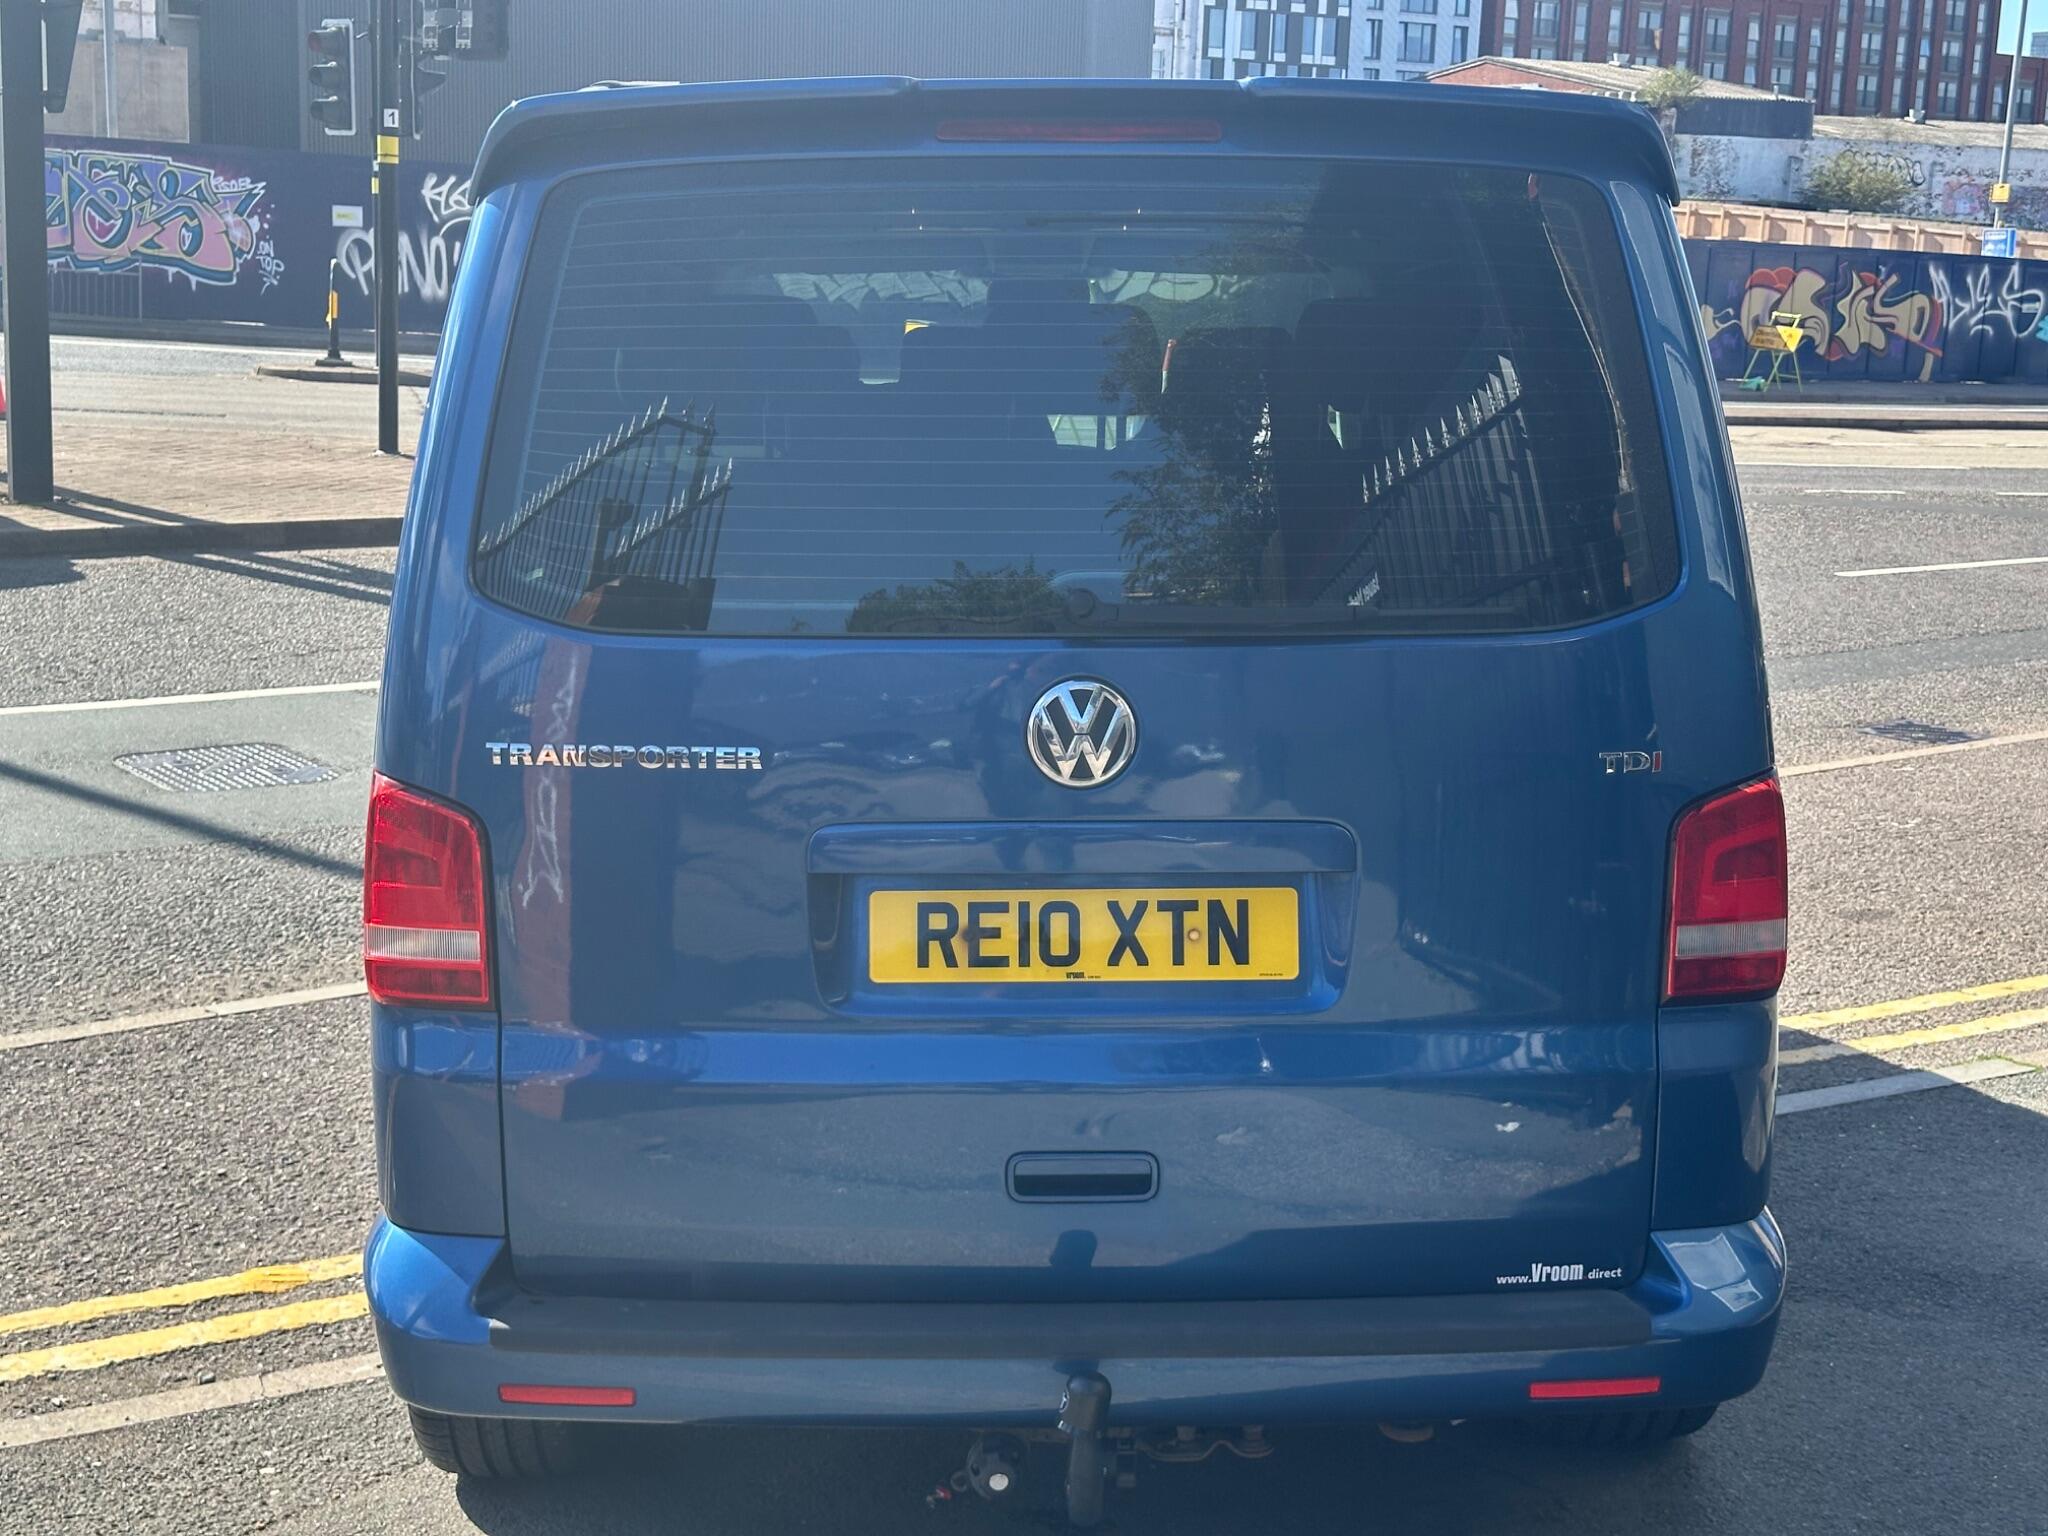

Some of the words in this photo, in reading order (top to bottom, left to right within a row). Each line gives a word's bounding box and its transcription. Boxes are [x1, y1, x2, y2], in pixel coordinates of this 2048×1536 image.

[388, 111, 396, 126] 1
[1028, 681, 1136, 787] VW
[486, 742, 763, 770] TRANSPORTER
[1599, 751, 1662, 773] TDI
[917, 901, 1081, 968] RE10
[1107, 899, 1250, 967] XTN
[1587, 1268, 1622, 1280] direct
